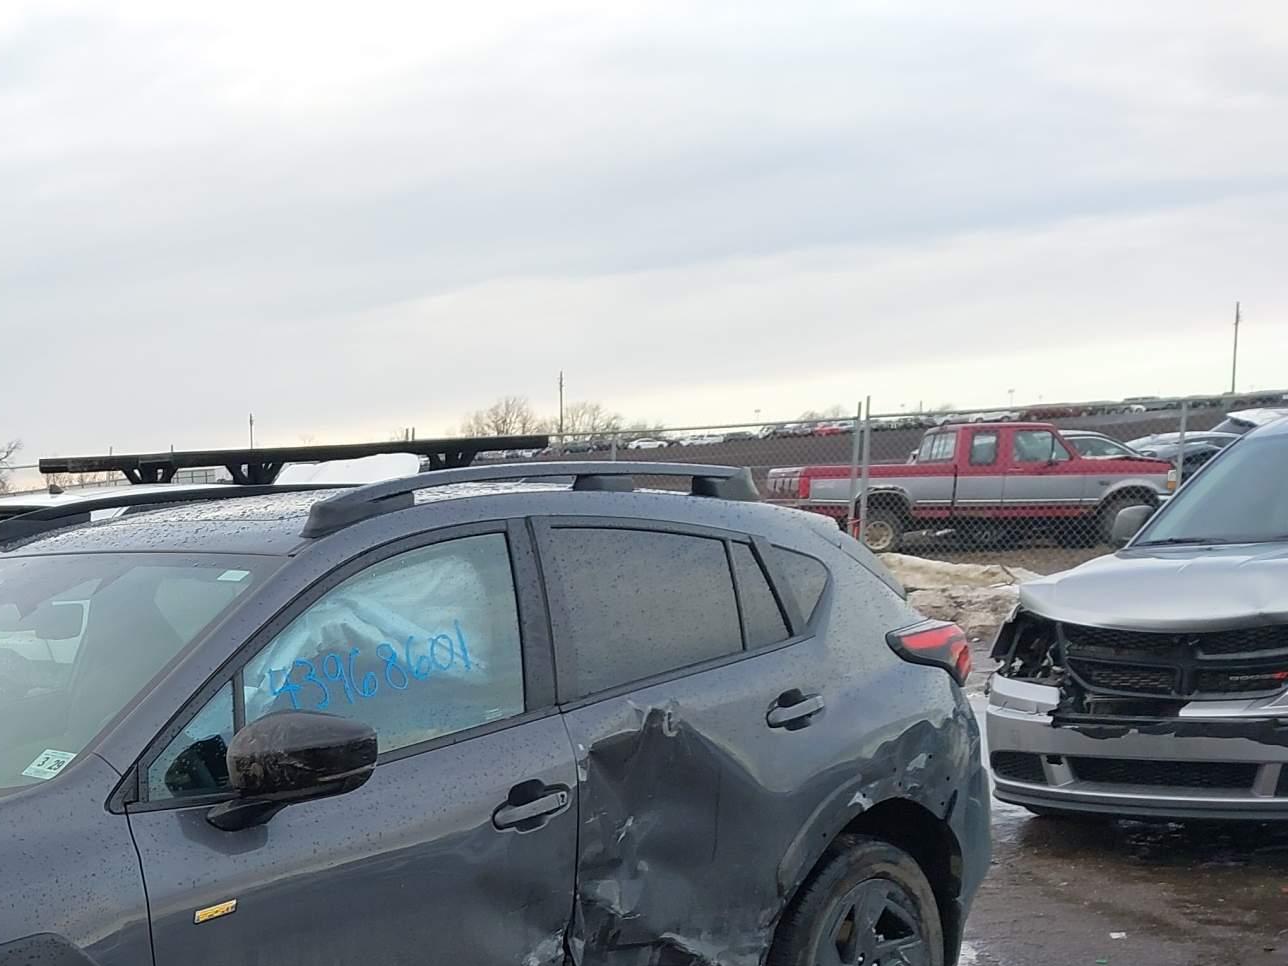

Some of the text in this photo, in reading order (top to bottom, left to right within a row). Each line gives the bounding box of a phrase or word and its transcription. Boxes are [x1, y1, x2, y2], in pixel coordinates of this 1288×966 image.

[268, 619, 472, 710] 43968601
[36, 756, 65, 771] 3 29
